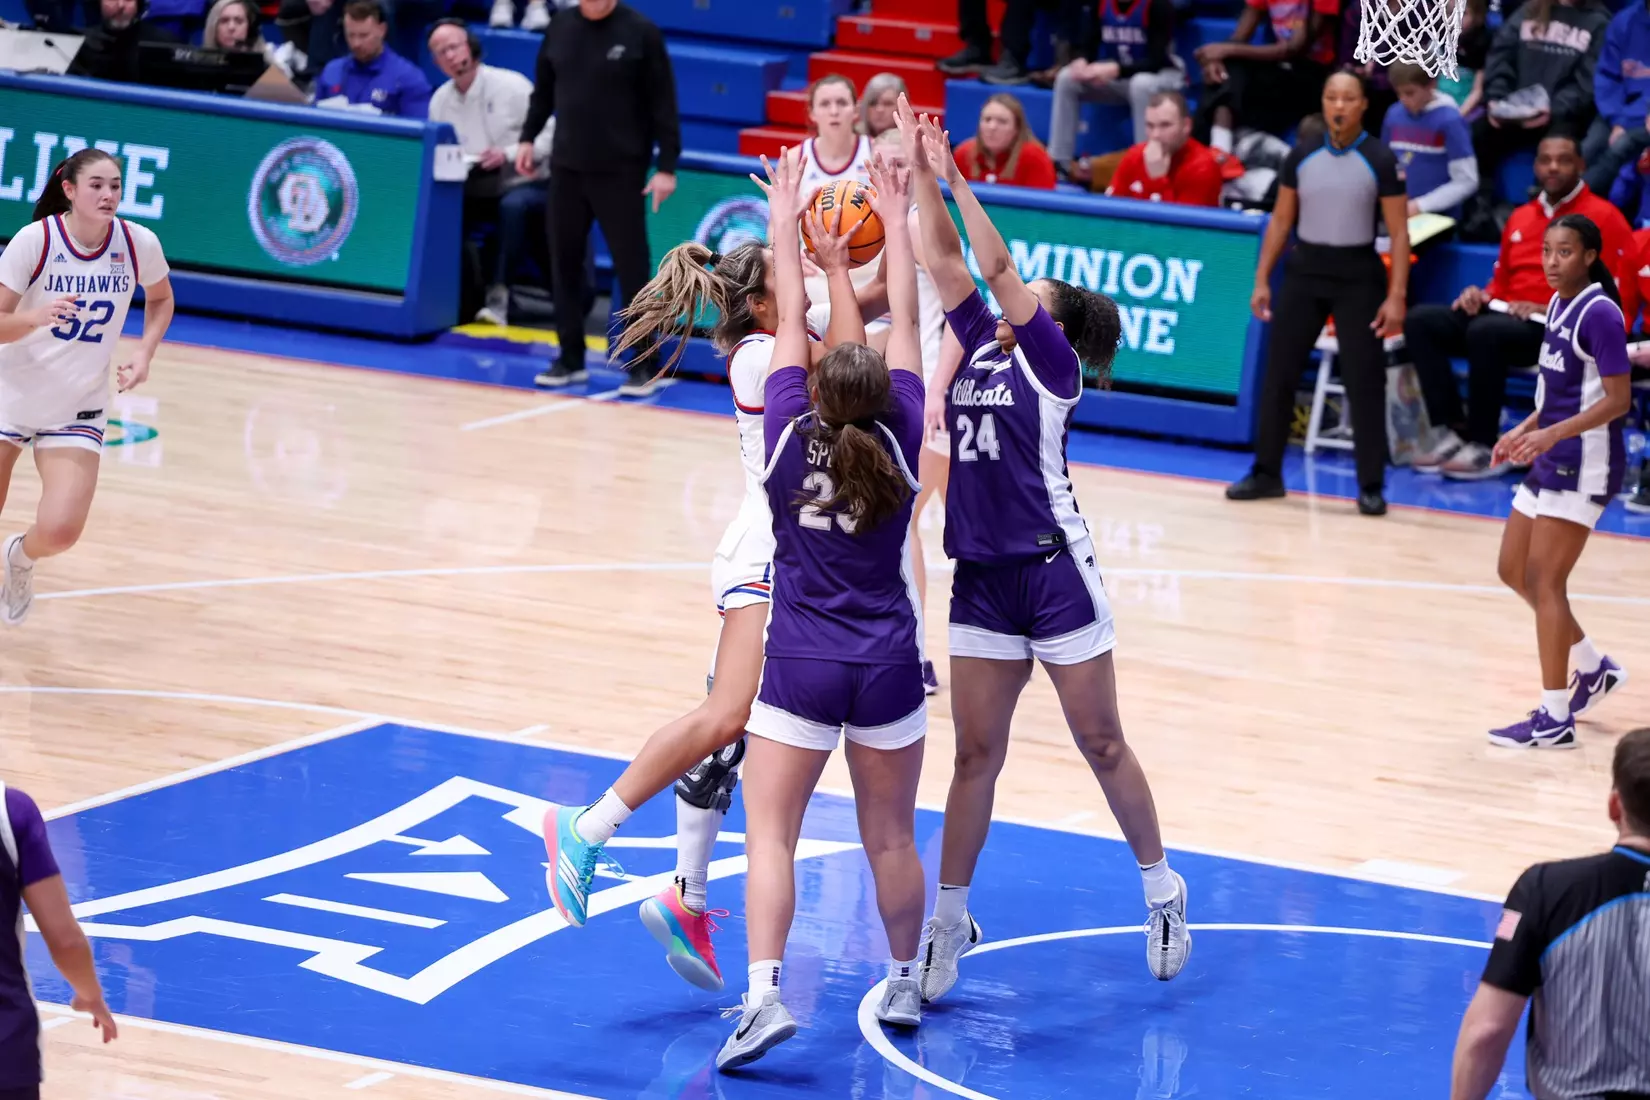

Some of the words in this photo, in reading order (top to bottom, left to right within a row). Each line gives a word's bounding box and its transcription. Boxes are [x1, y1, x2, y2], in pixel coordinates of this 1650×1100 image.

[0, 126, 170, 220] LIE
[44, 274, 130, 294] JAYHAWKS
[960, 236, 1203, 304] MINION
[1115, 304, 1179, 355] NE
[956, 413, 1001, 462] 24
